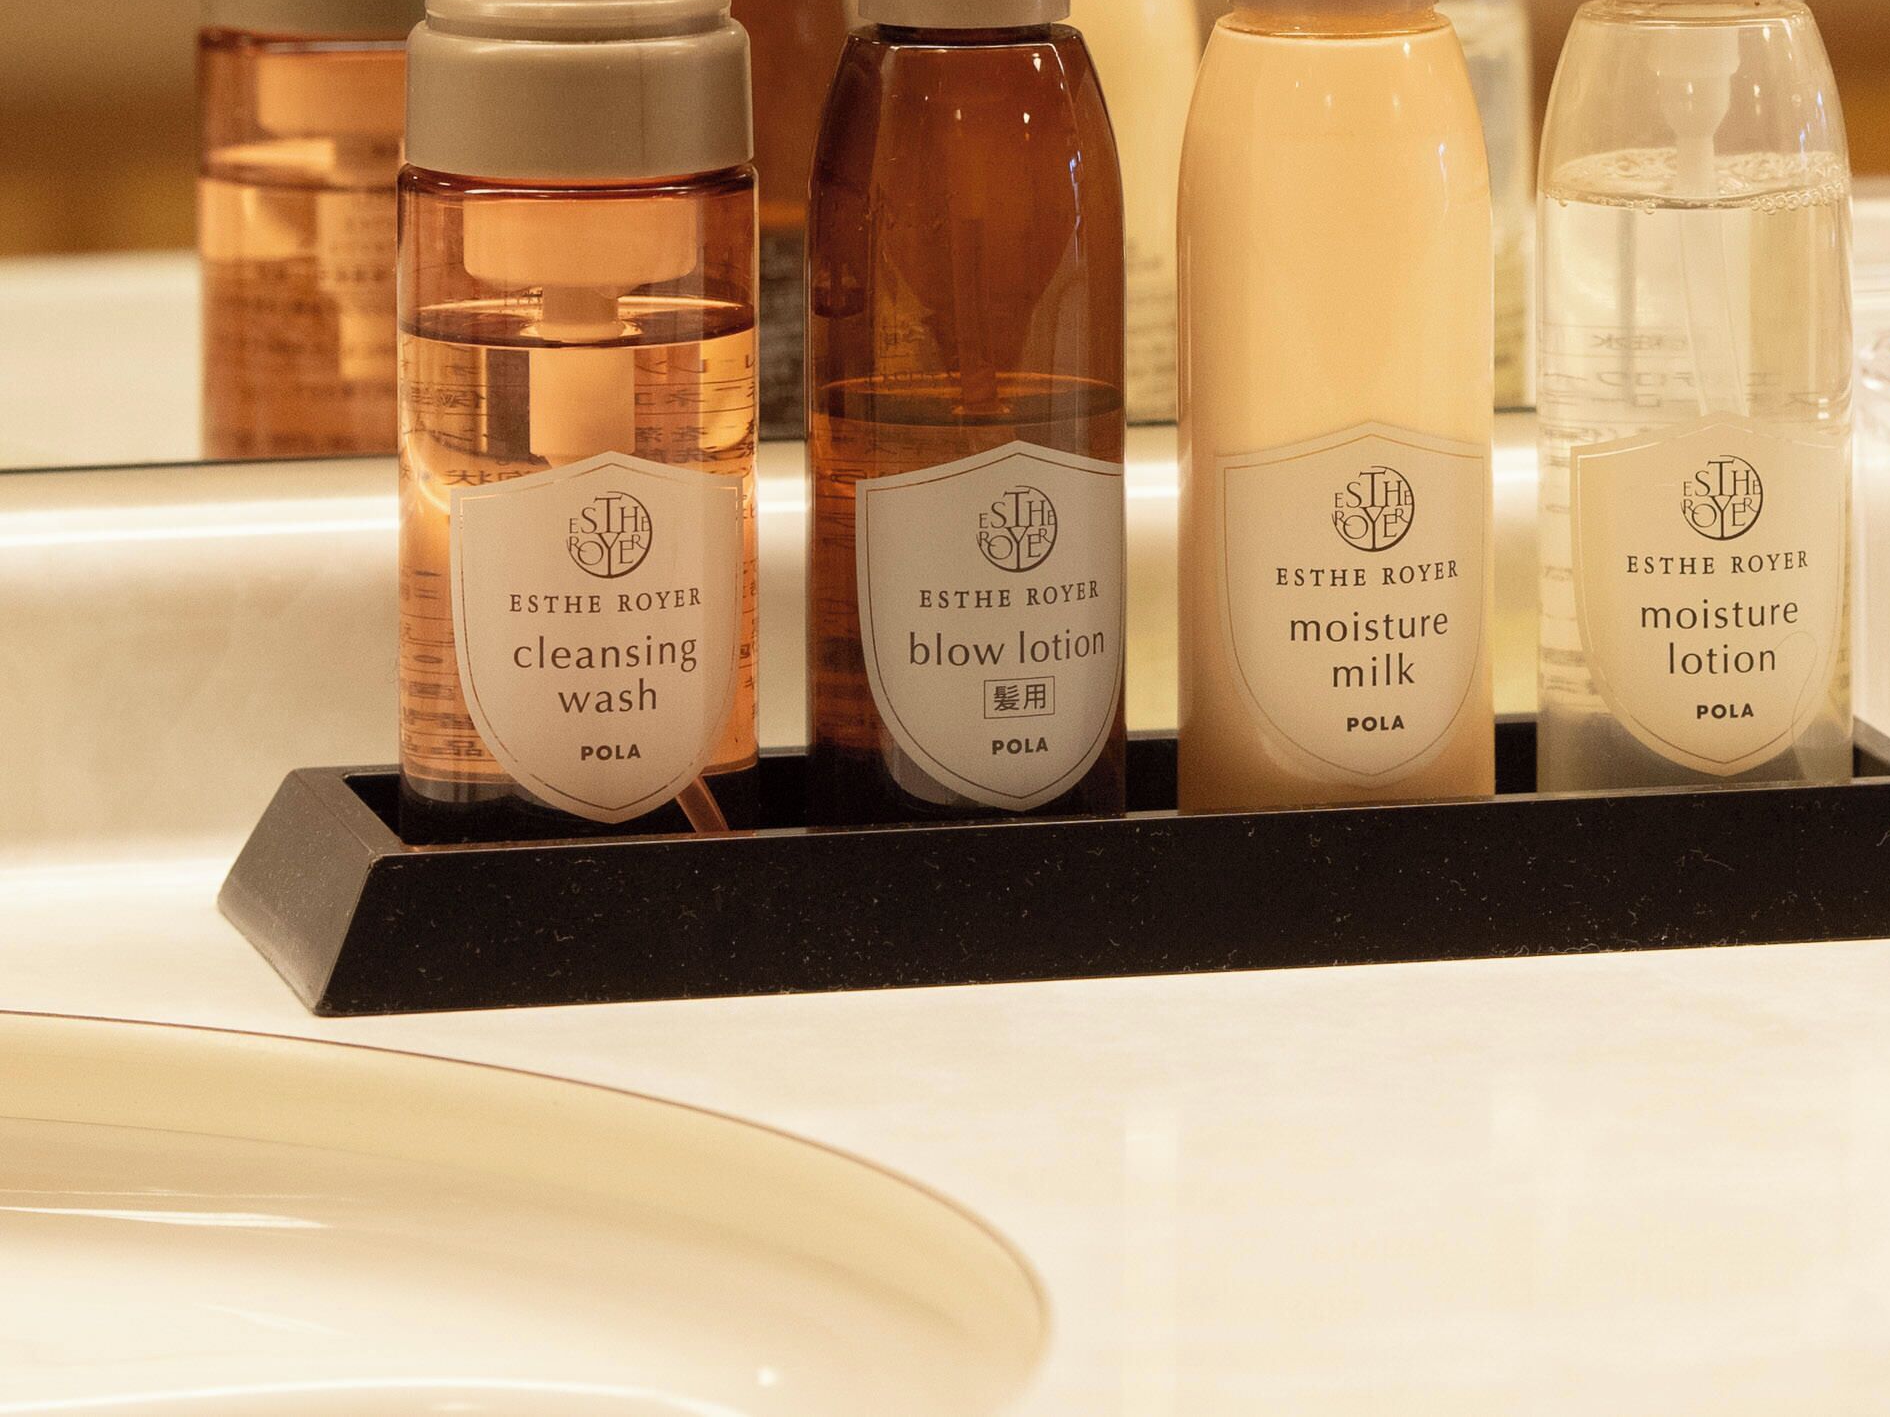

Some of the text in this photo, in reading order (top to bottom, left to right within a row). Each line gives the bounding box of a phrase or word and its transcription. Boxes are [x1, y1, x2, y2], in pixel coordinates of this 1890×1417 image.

[1334, 469, 1413, 509] ESTHE
[1683, 458, 1763, 497] ESTHE
[569, 496, 652, 534] ESTHE
[978, 490, 1056, 528] ESTHE
[1680, 494, 1760, 541] ROYER
[1332, 506, 1410, 552] ROYER
[567, 531, 648, 578] ROYER
[977, 525, 1052, 571] ROYER
[1626, 550, 1809, 575] ESTHE ROYER
[1275, 560, 1458, 587] ESTHE ROYER
[509, 587, 702, 614] ESTHE ROYER
[919, 580, 1100, 609] ESTHE ROYER
[1289, 611, 1449, 643] moisture
[1640, 598, 1799, 629] moisture
[513, 635, 698, 673] cleansing
[909, 628, 1105, 667] blow lotion
[1668, 641, 1776, 675] lotion
[1332, 652, 1415, 688] milk
[557, 678, 658, 714] wash
[993, 683, 1048, 712] 髪用
[1696, 702, 1754, 720] POLA
[1346, 715, 1405, 732] POLA
[580, 743, 641, 761] POLA
[991, 737, 1049, 755] POLA
